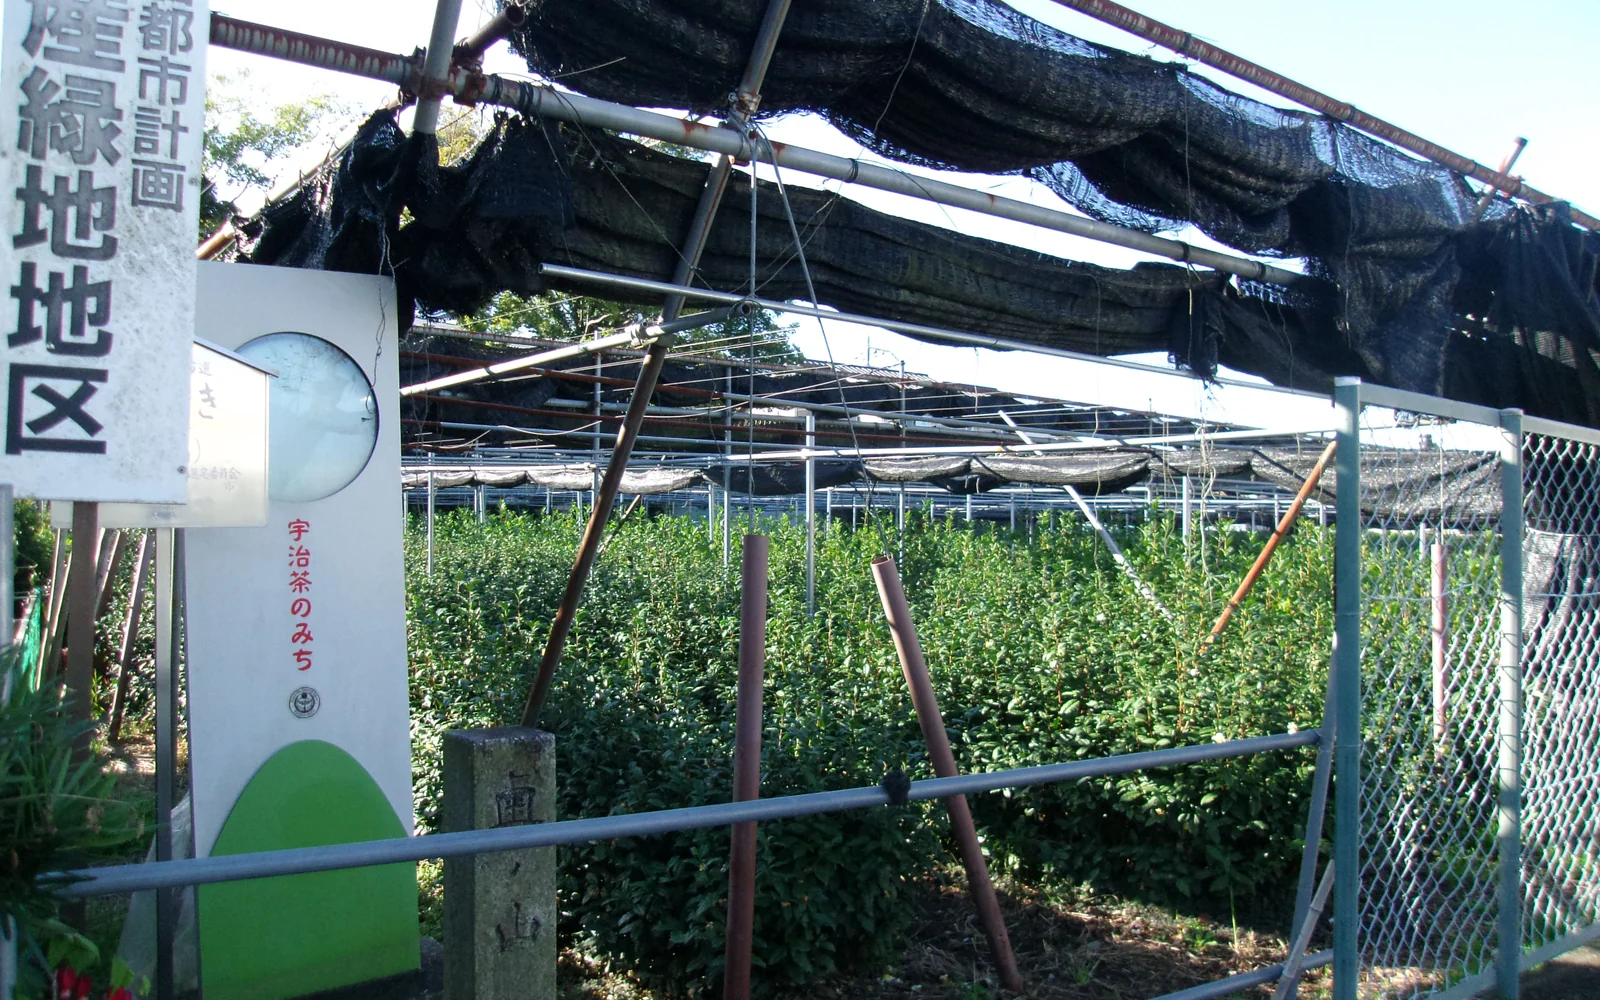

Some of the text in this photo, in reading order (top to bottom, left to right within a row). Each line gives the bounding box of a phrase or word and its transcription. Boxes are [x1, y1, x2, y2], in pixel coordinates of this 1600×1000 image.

[131, 0, 193, 213] 都市計画
[287, 518, 314, 671] 宇治茶のみち
